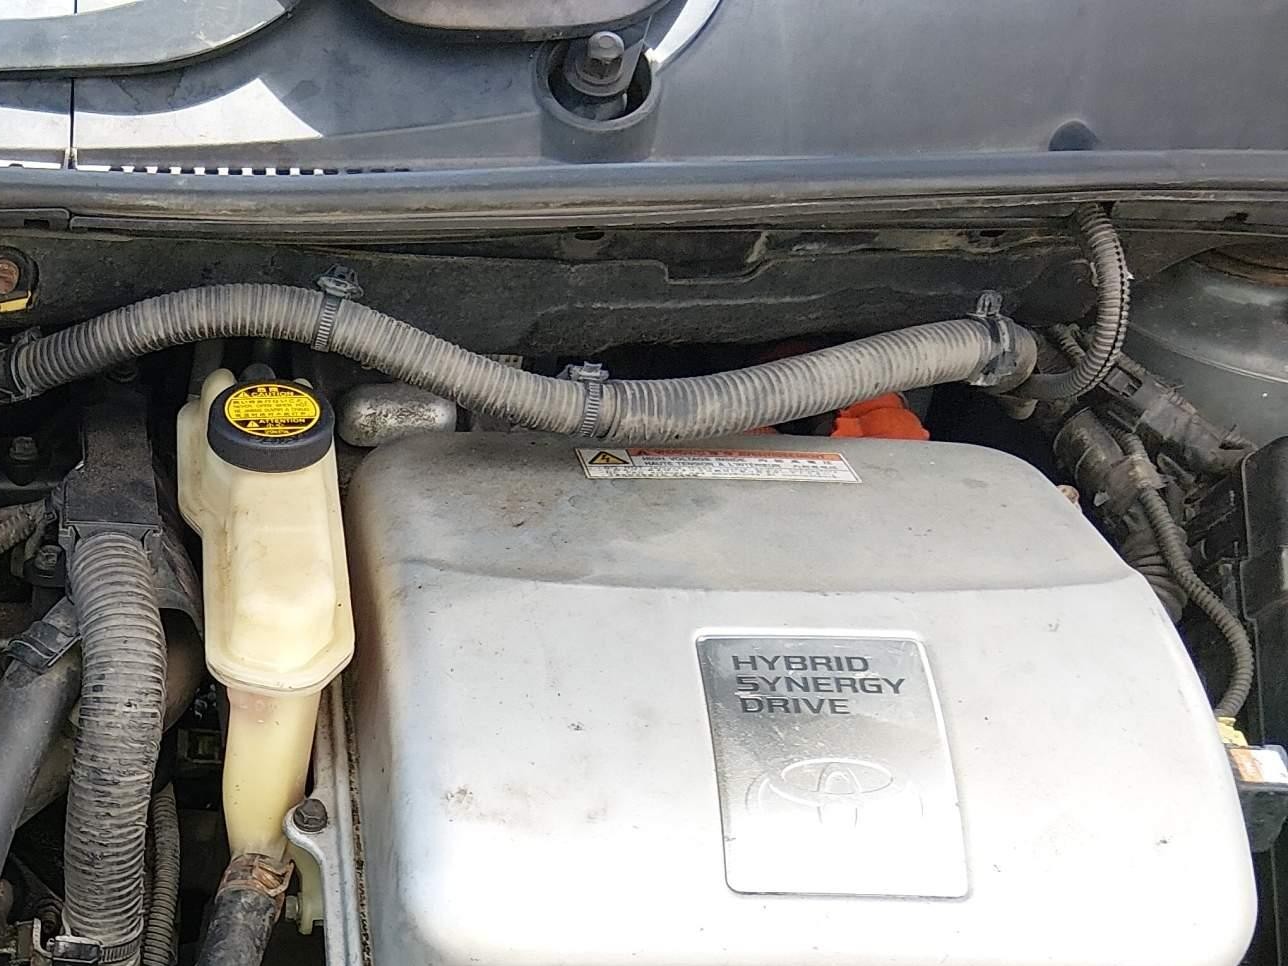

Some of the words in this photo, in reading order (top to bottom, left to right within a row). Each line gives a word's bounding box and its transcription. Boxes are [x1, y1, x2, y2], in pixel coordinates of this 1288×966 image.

[731, 655, 870, 672] HYBRID
[735, 675, 905, 694] SYNERGY
[739, 697, 851, 715] DRIVE
